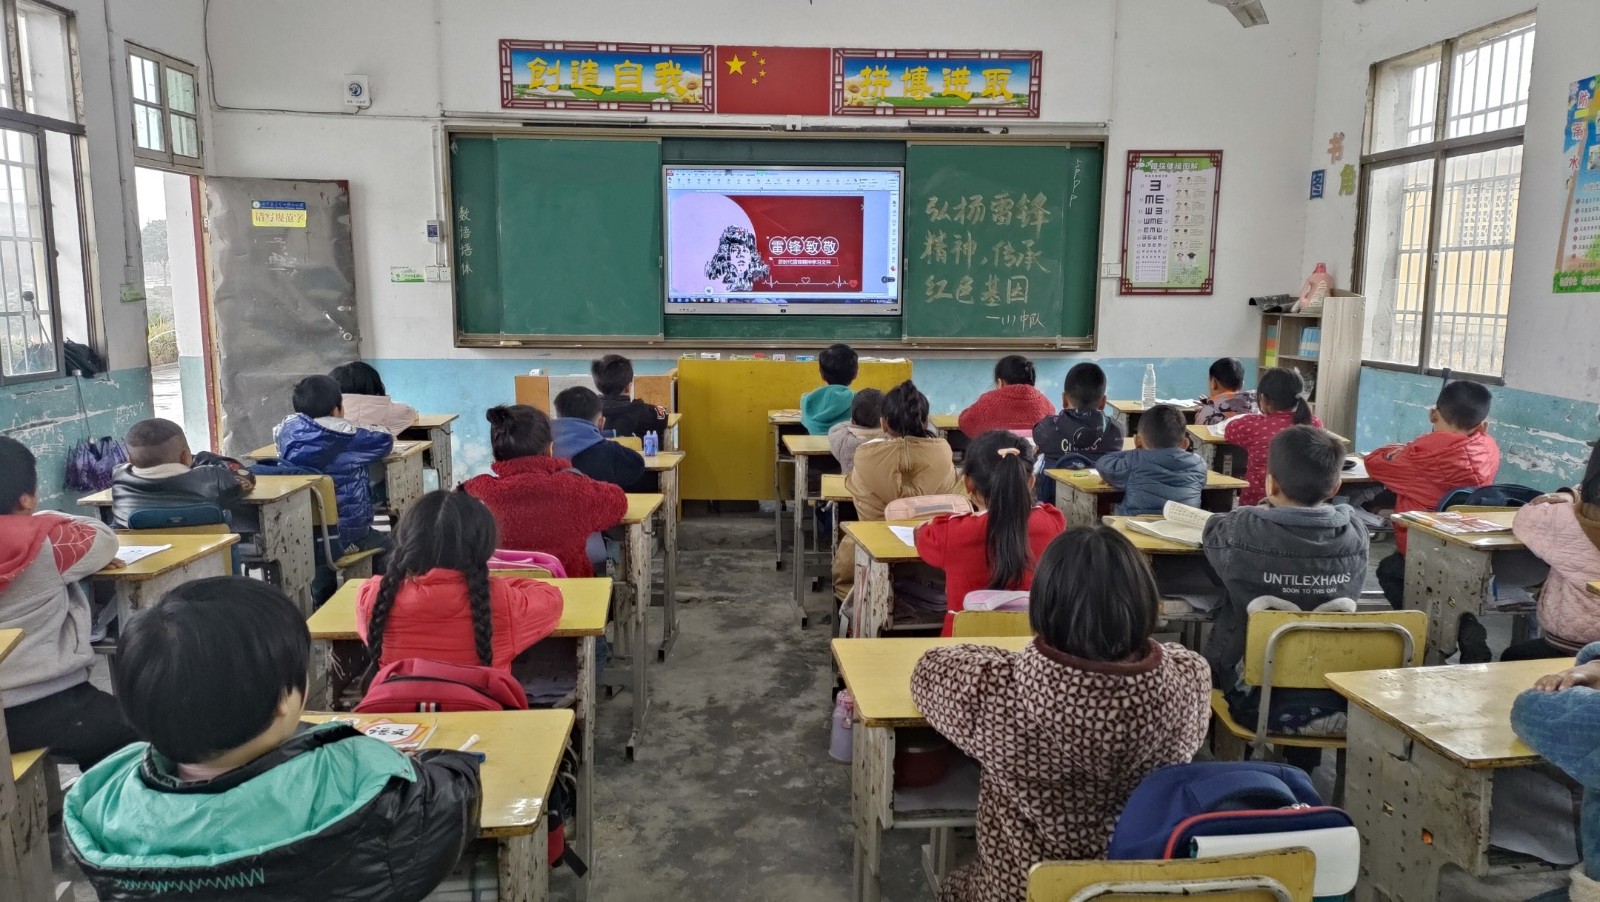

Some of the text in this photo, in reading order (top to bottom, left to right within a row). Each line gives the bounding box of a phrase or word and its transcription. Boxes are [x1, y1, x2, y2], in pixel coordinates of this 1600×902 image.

[527, 57, 687, 96] 創造自我
[859, 64, 1014, 101] 拼博进取
[255, 212, 305, 223] 请写规范字
[926, 192, 1051, 238] 弘扬雷锋
[771, 240, 837, 254] 雷锋致敬
[925, 274, 1029, 306] 红色基因
[1263, 572, 1351, 586] UNTILEXHAUS
